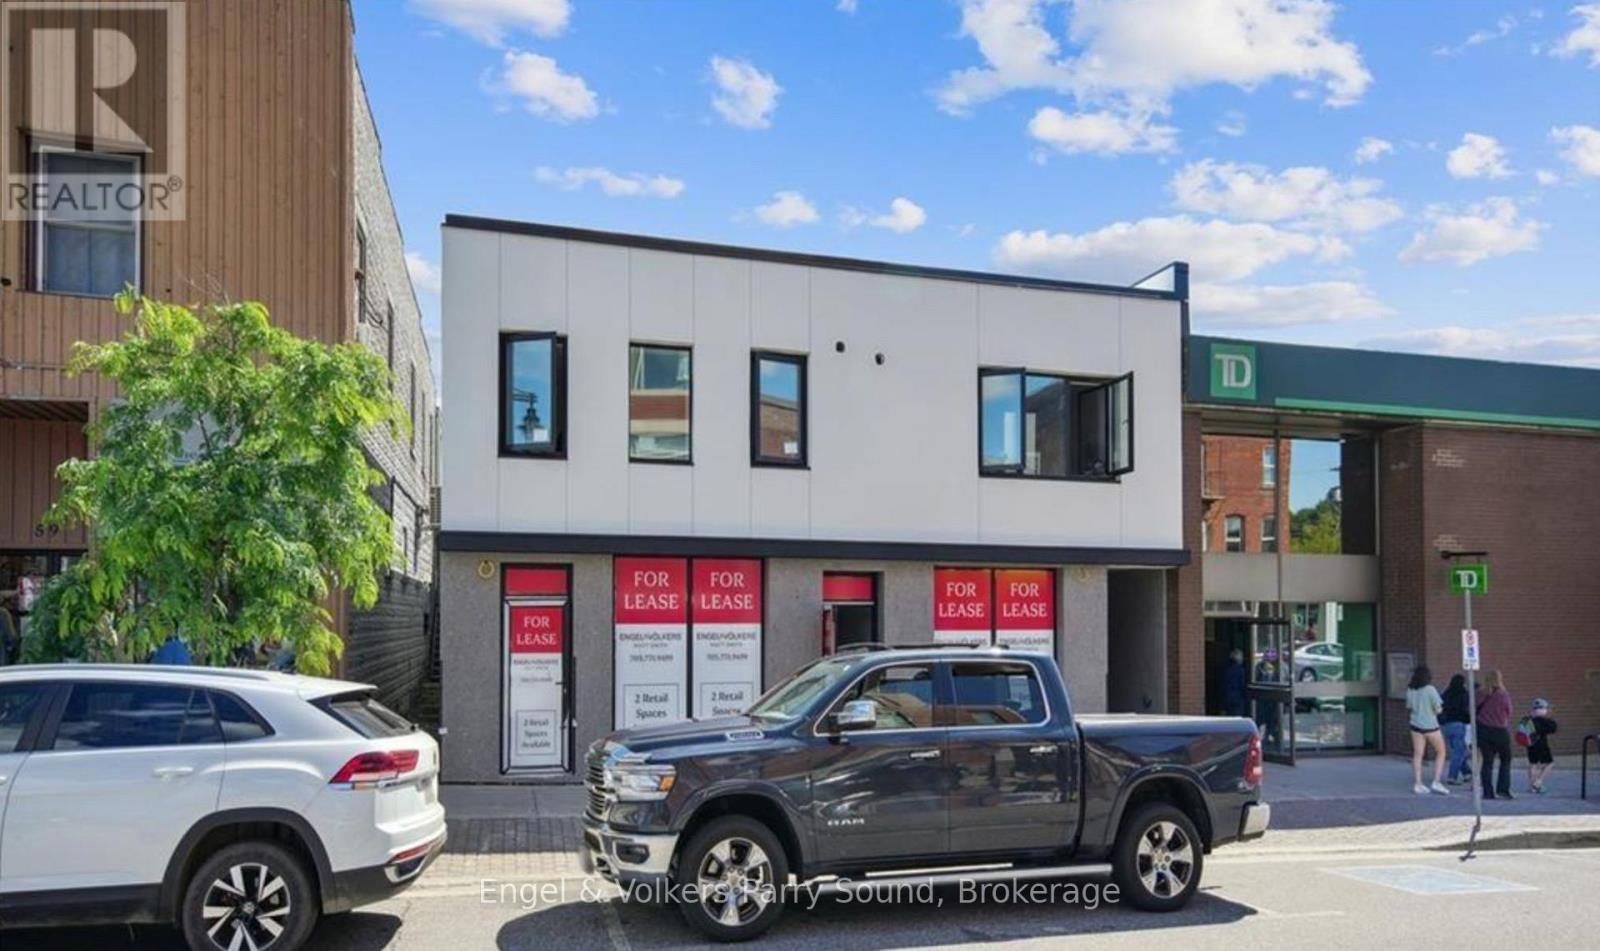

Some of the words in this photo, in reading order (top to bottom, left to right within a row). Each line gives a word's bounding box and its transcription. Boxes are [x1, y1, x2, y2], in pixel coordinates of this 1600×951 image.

[1214, 353, 1252, 388] TD
[34, 524, 59, 538] 59
[633, 571, 669, 588] FOR
[710, 571, 745, 588] FOR
[1455, 569, 1478, 588] TD
[946, 582, 977, 597] FOR
[1010, 582, 1039, 597] FOR
[624, 594, 680, 610] LEASE
[701, 594, 754, 610] LEASE
[939, 603, 984, 617] LEASE
[1003, 603, 1047, 617] LEASE
[523, 615, 550, 629] FOR
[516, 633, 557, 646] LEASE
[635, 693, 641, 704] 2
[643, 692, 669, 703] Retail
[711, 691, 717, 701] 2
[719, 691, 744, 701] Retail
[636, 708, 667, 719] Spaces
[828, 818, 865, 826] RAM
